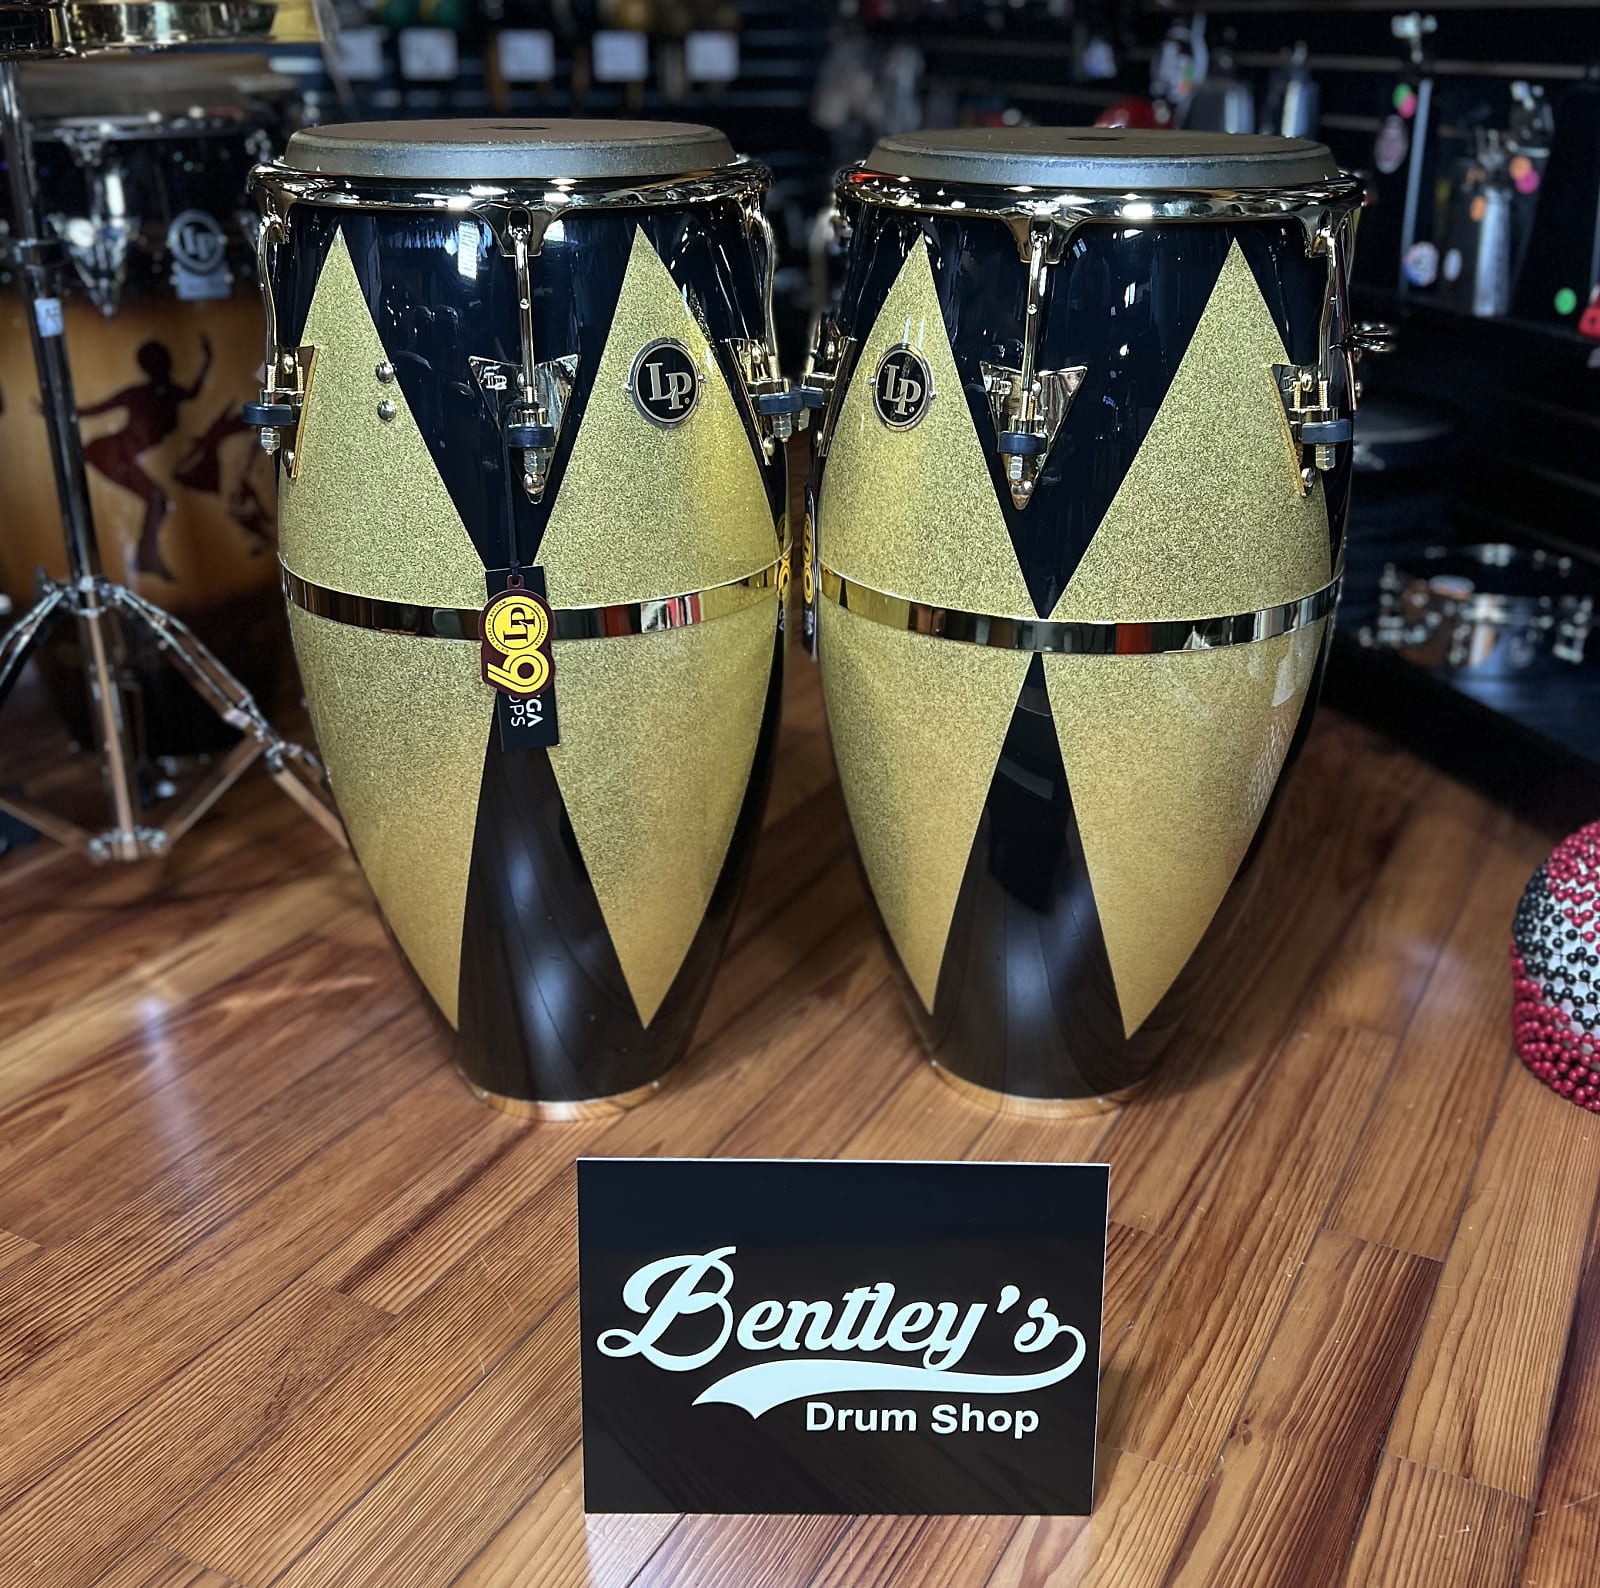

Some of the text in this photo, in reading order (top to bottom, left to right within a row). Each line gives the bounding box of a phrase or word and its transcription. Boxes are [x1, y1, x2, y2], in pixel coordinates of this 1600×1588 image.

[646, 363, 692, 410] LP
[882, 364, 922, 415] LP
[503, 606, 536, 643] LP
[526, 694, 543, 727] GA
[597, 1246, 1060, 1371] Bentley's
[806, 1402, 1040, 1439] Drum Shop
